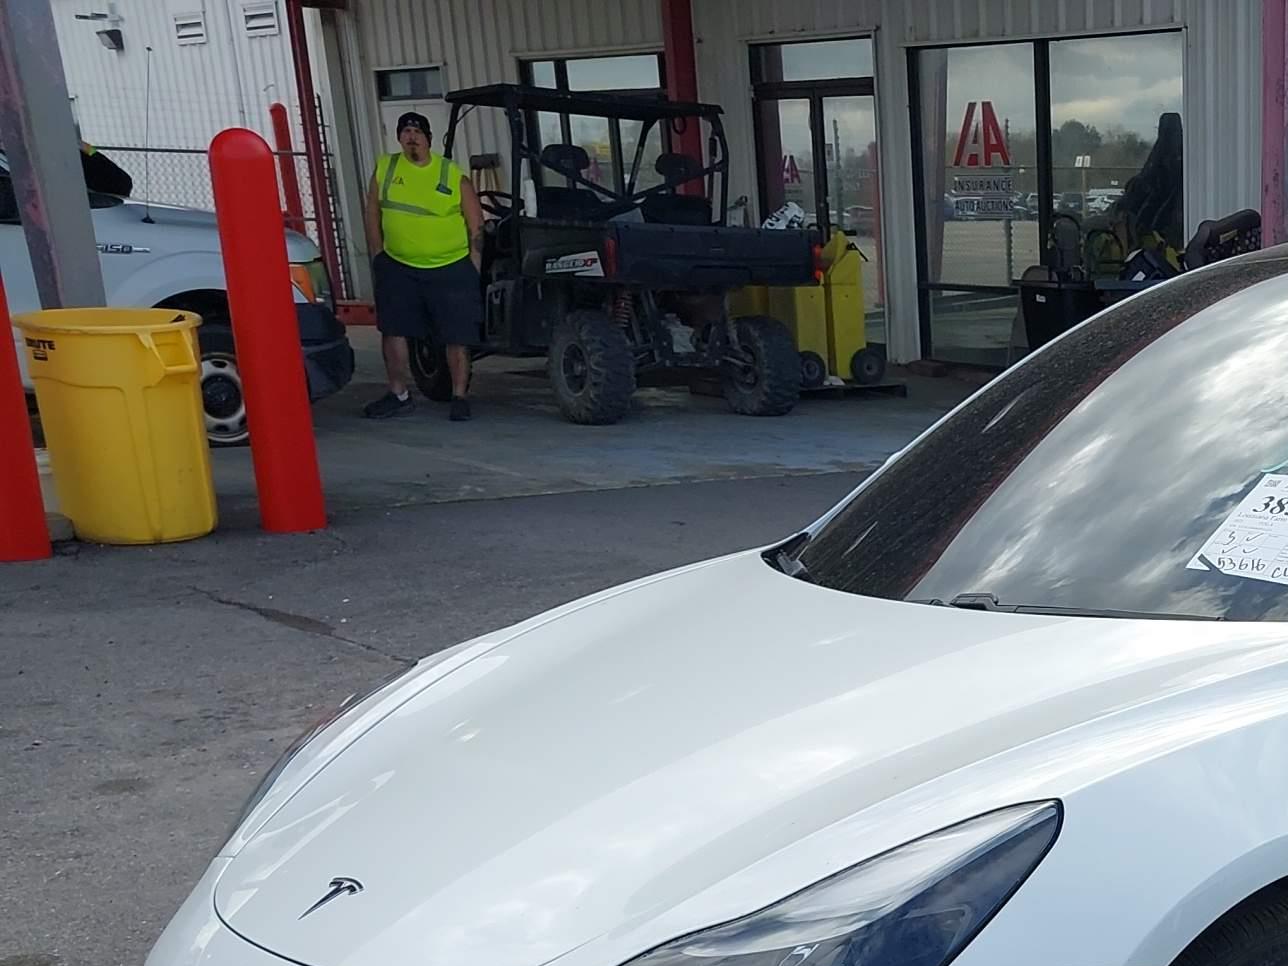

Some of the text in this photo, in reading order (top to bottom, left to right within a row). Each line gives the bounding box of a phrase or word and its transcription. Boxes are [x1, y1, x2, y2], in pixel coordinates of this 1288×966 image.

[953, 180, 1013, 192] INSURANCE
[954, 200, 1015, 212] AUTO AUCTIONS
